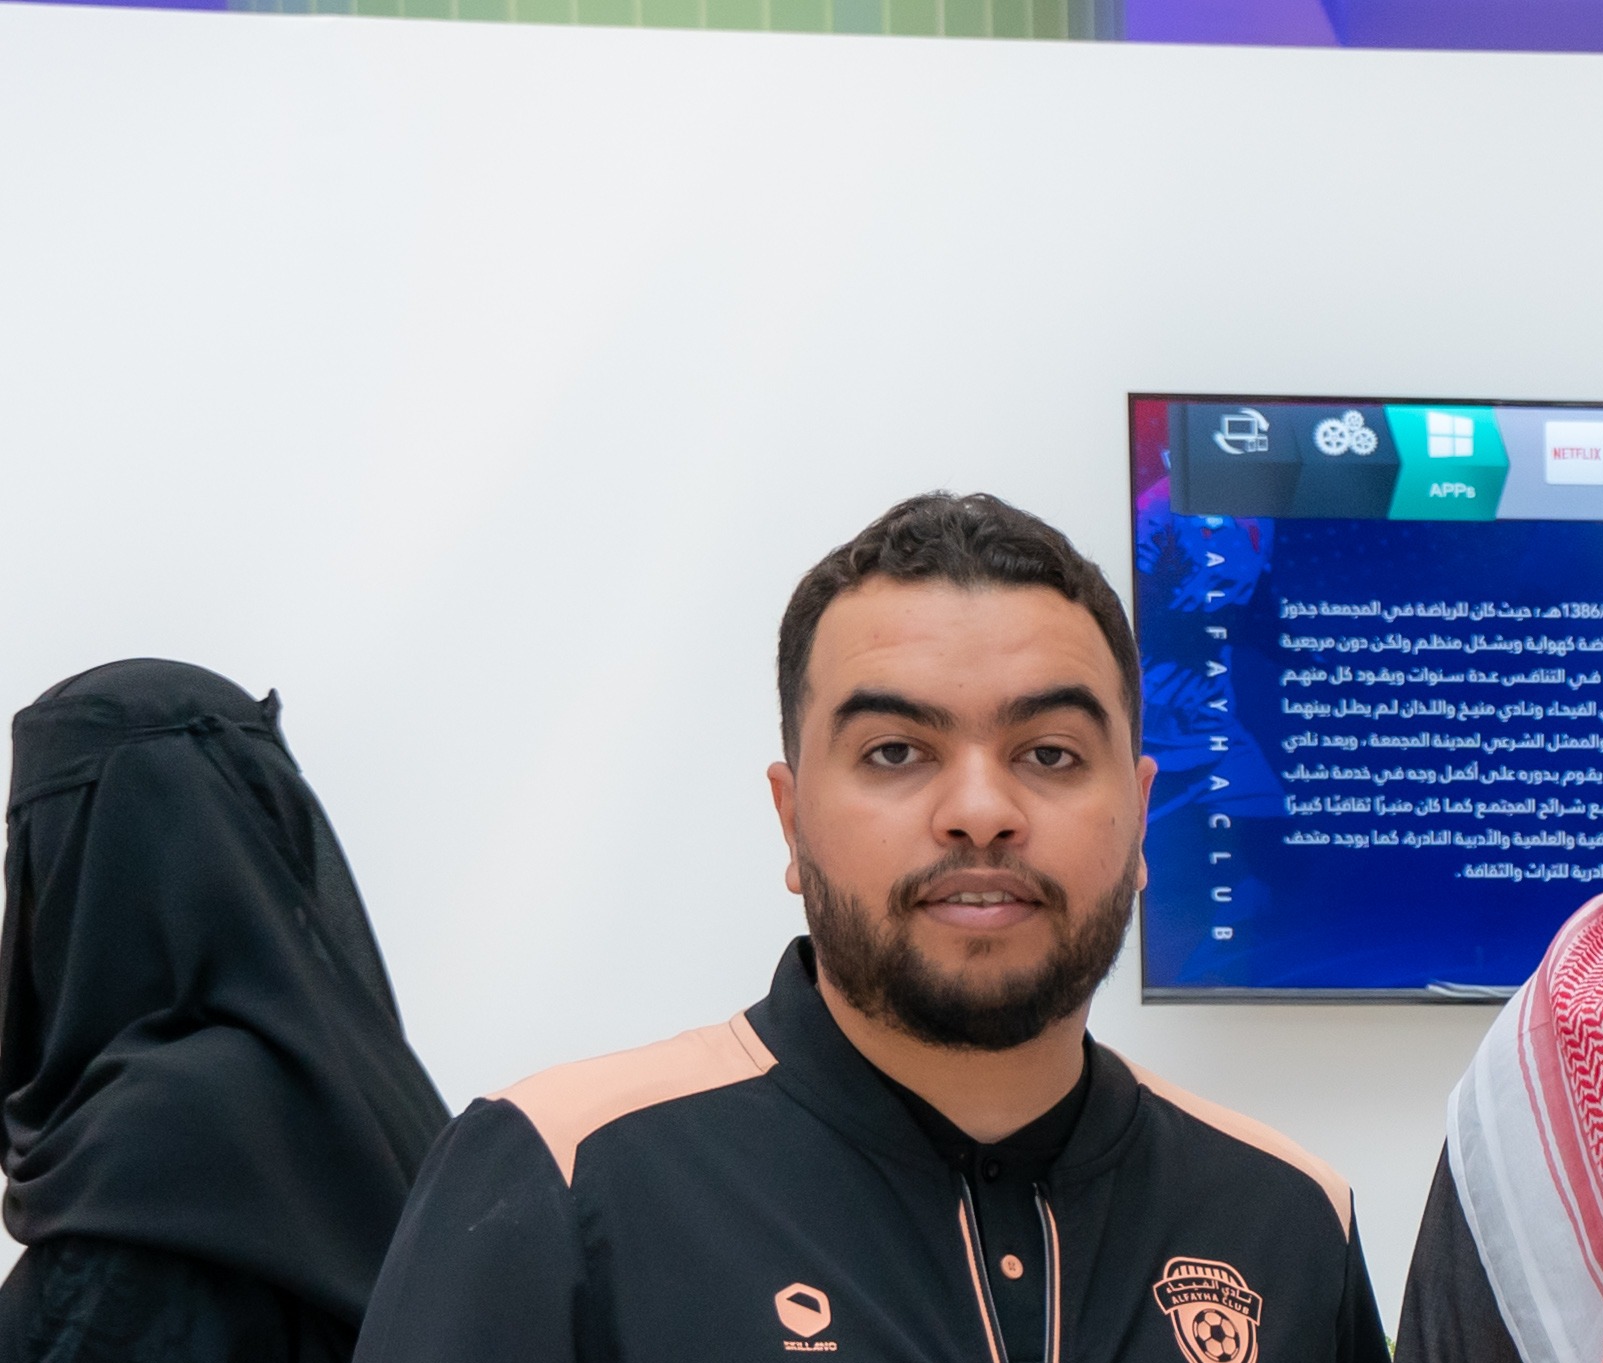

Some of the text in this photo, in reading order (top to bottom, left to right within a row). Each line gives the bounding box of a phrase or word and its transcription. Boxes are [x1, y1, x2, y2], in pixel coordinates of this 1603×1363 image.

[1553, 447, 1601, 461] NETFLIX
[1429, 482, 1476, 499] APPs
[1318, 600, 1381, 619] المجمعة
[1382, 603, 1414, 623] في
[1415, 601, 1469, 621] للرياضة
[1469, 602, 1496, 621] كان
[1497, 602, 1532, 621] حيث
[1279, 633, 1335, 651] مرجعية
[1335, 636, 1368, 653] دون
[1369, 634, 1412, 653] ولكن
[1413, 634, 1462, 655] منظم
[1464, 634, 1523, 654] وبشكل
[1525, 635, 1575, 656] كهواية
[1280, 666, 1327, 687] منهم
[1328, 665, 1353, 685] كل
[1355, 667, 1405, 686] ويقود
[1407, 666, 1464, 686] سنوات
[1466, 667, 1499, 683] عدة
[1501, 668, 1566, 687] التنافس
[1567, 670, 1602, 690] في
[1281, 698, 1331, 720] بينهما
[1372, 699, 1398, 720] لم
[1400, 699, 1456, 720] واللذان
[1497, 701, 1544, 722] ونادي
[1546, 701, 1597, 720] الفيحاء
[1281, 731, 1318, 753] نادي
[1321, 733, 1358, 751] ويعد
[1368, 731, 1430, 750] المجمعة
[1431, 732, 1481, 751] لمدينة
[1482, 733, 1544, 754] الشرعي
[1281, 763, 1329, 782] شباب
[1330, 765, 1371, 780] خدمة
[1373, 766, 1405, 786] في
[1405, 767, 1436, 784] وجه
[1437, 761, 1478, 784] أكمل
[1480, 765, 1515, 784] على
[1516, 769, 1559, 785] بدوره
[1561, 766, 1603, 787] يقوم
[1414, 797, 1441, 816] كان
[1442, 797, 1473, 813] كما
[1474, 798, 1536, 820] المجتمع
[1538, 798, 1586, 820] شرائح
[1283, 829, 1330, 845] متحف
[1333, 833, 1370, 849] يوجد
[1371, 829, 1399, 845] كما
[1454, 828, 1511, 850] والأدبية
[1512, 830, 1575, 850] والعلمية
[1462, 861, 1522, 882] والثقافة
[1523, 862, 1569, 882] للتراث
[1166, 1280, 1252, 1304] نادي الفيحاء
[1171, 1292, 1250, 1315] ALFAYHA CLUB
